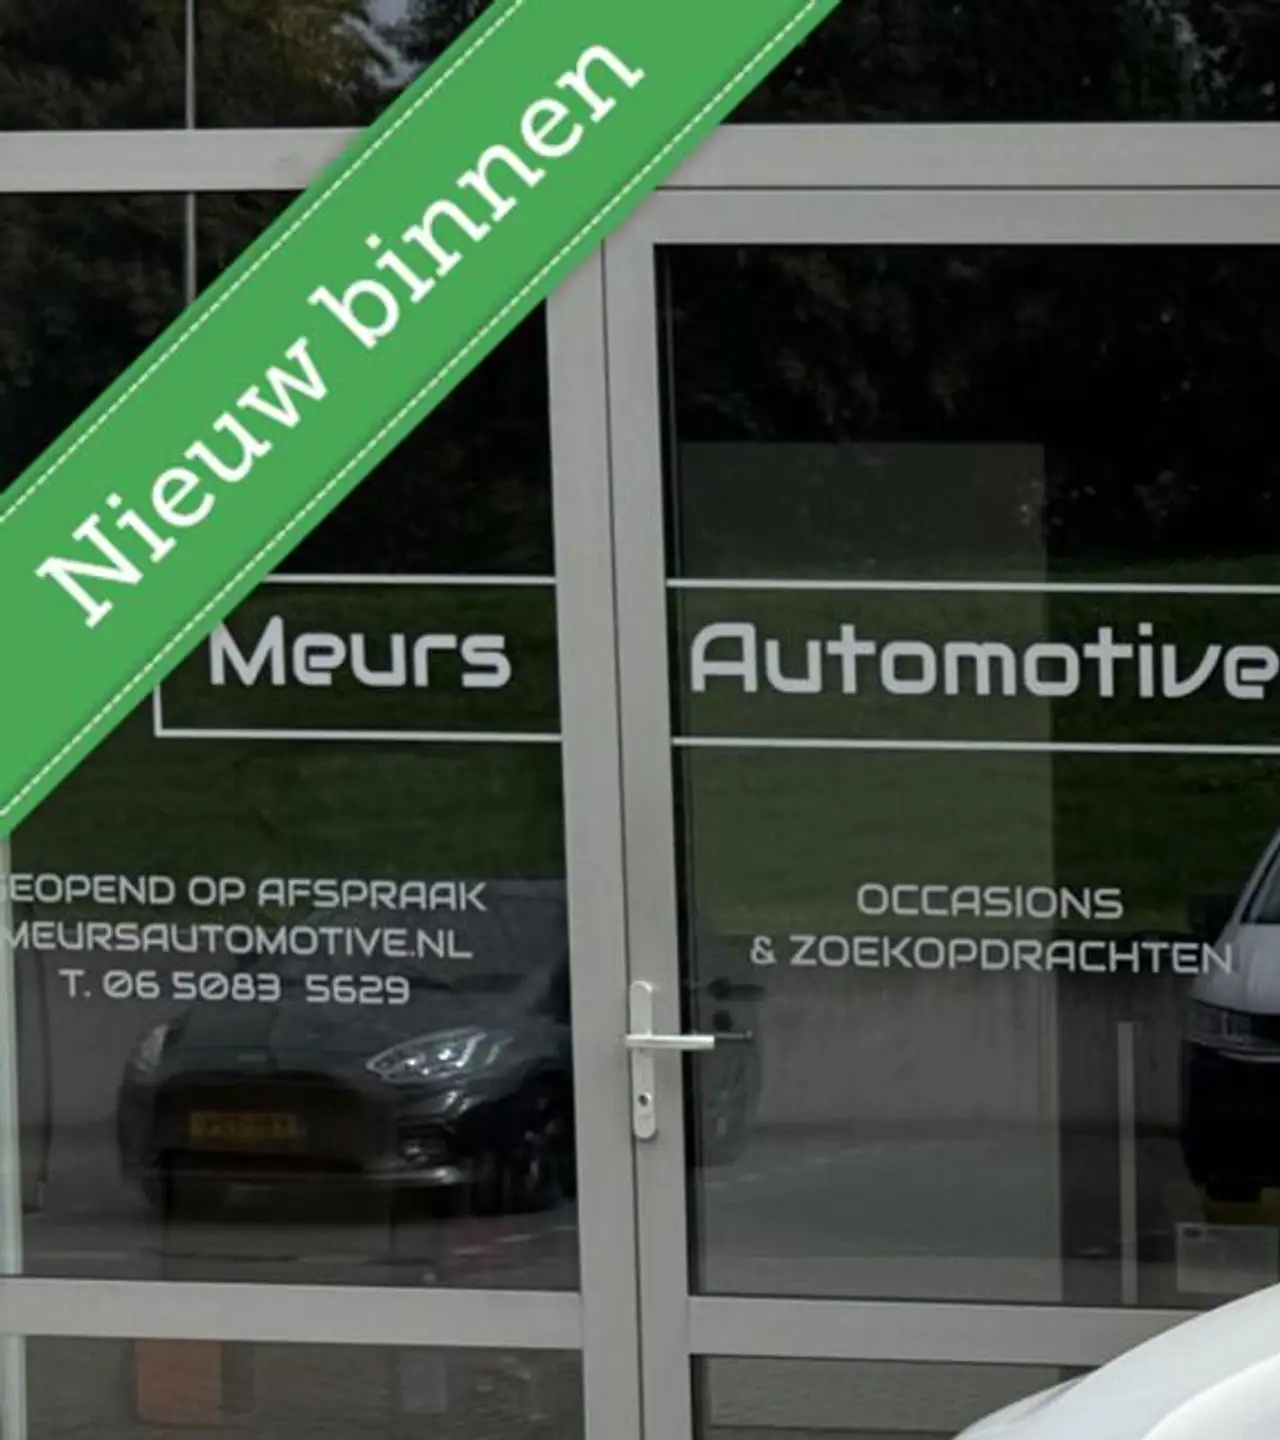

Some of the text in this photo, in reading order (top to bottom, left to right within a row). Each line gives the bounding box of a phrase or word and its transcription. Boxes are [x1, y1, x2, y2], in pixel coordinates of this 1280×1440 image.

[209, 615, 512, 688] Meurs
[690, 622, 1280, 699] Automotive
[188, 874, 246, 907] OP
[257, 877, 487, 912] AFSPRAAK
[856, 883, 1125, 921] OCCASIONS
[750, 934, 1234, 973] & ZOEKOPDRACHTEN
[58, 968, 411, 1005] T. 06 5083 5629
